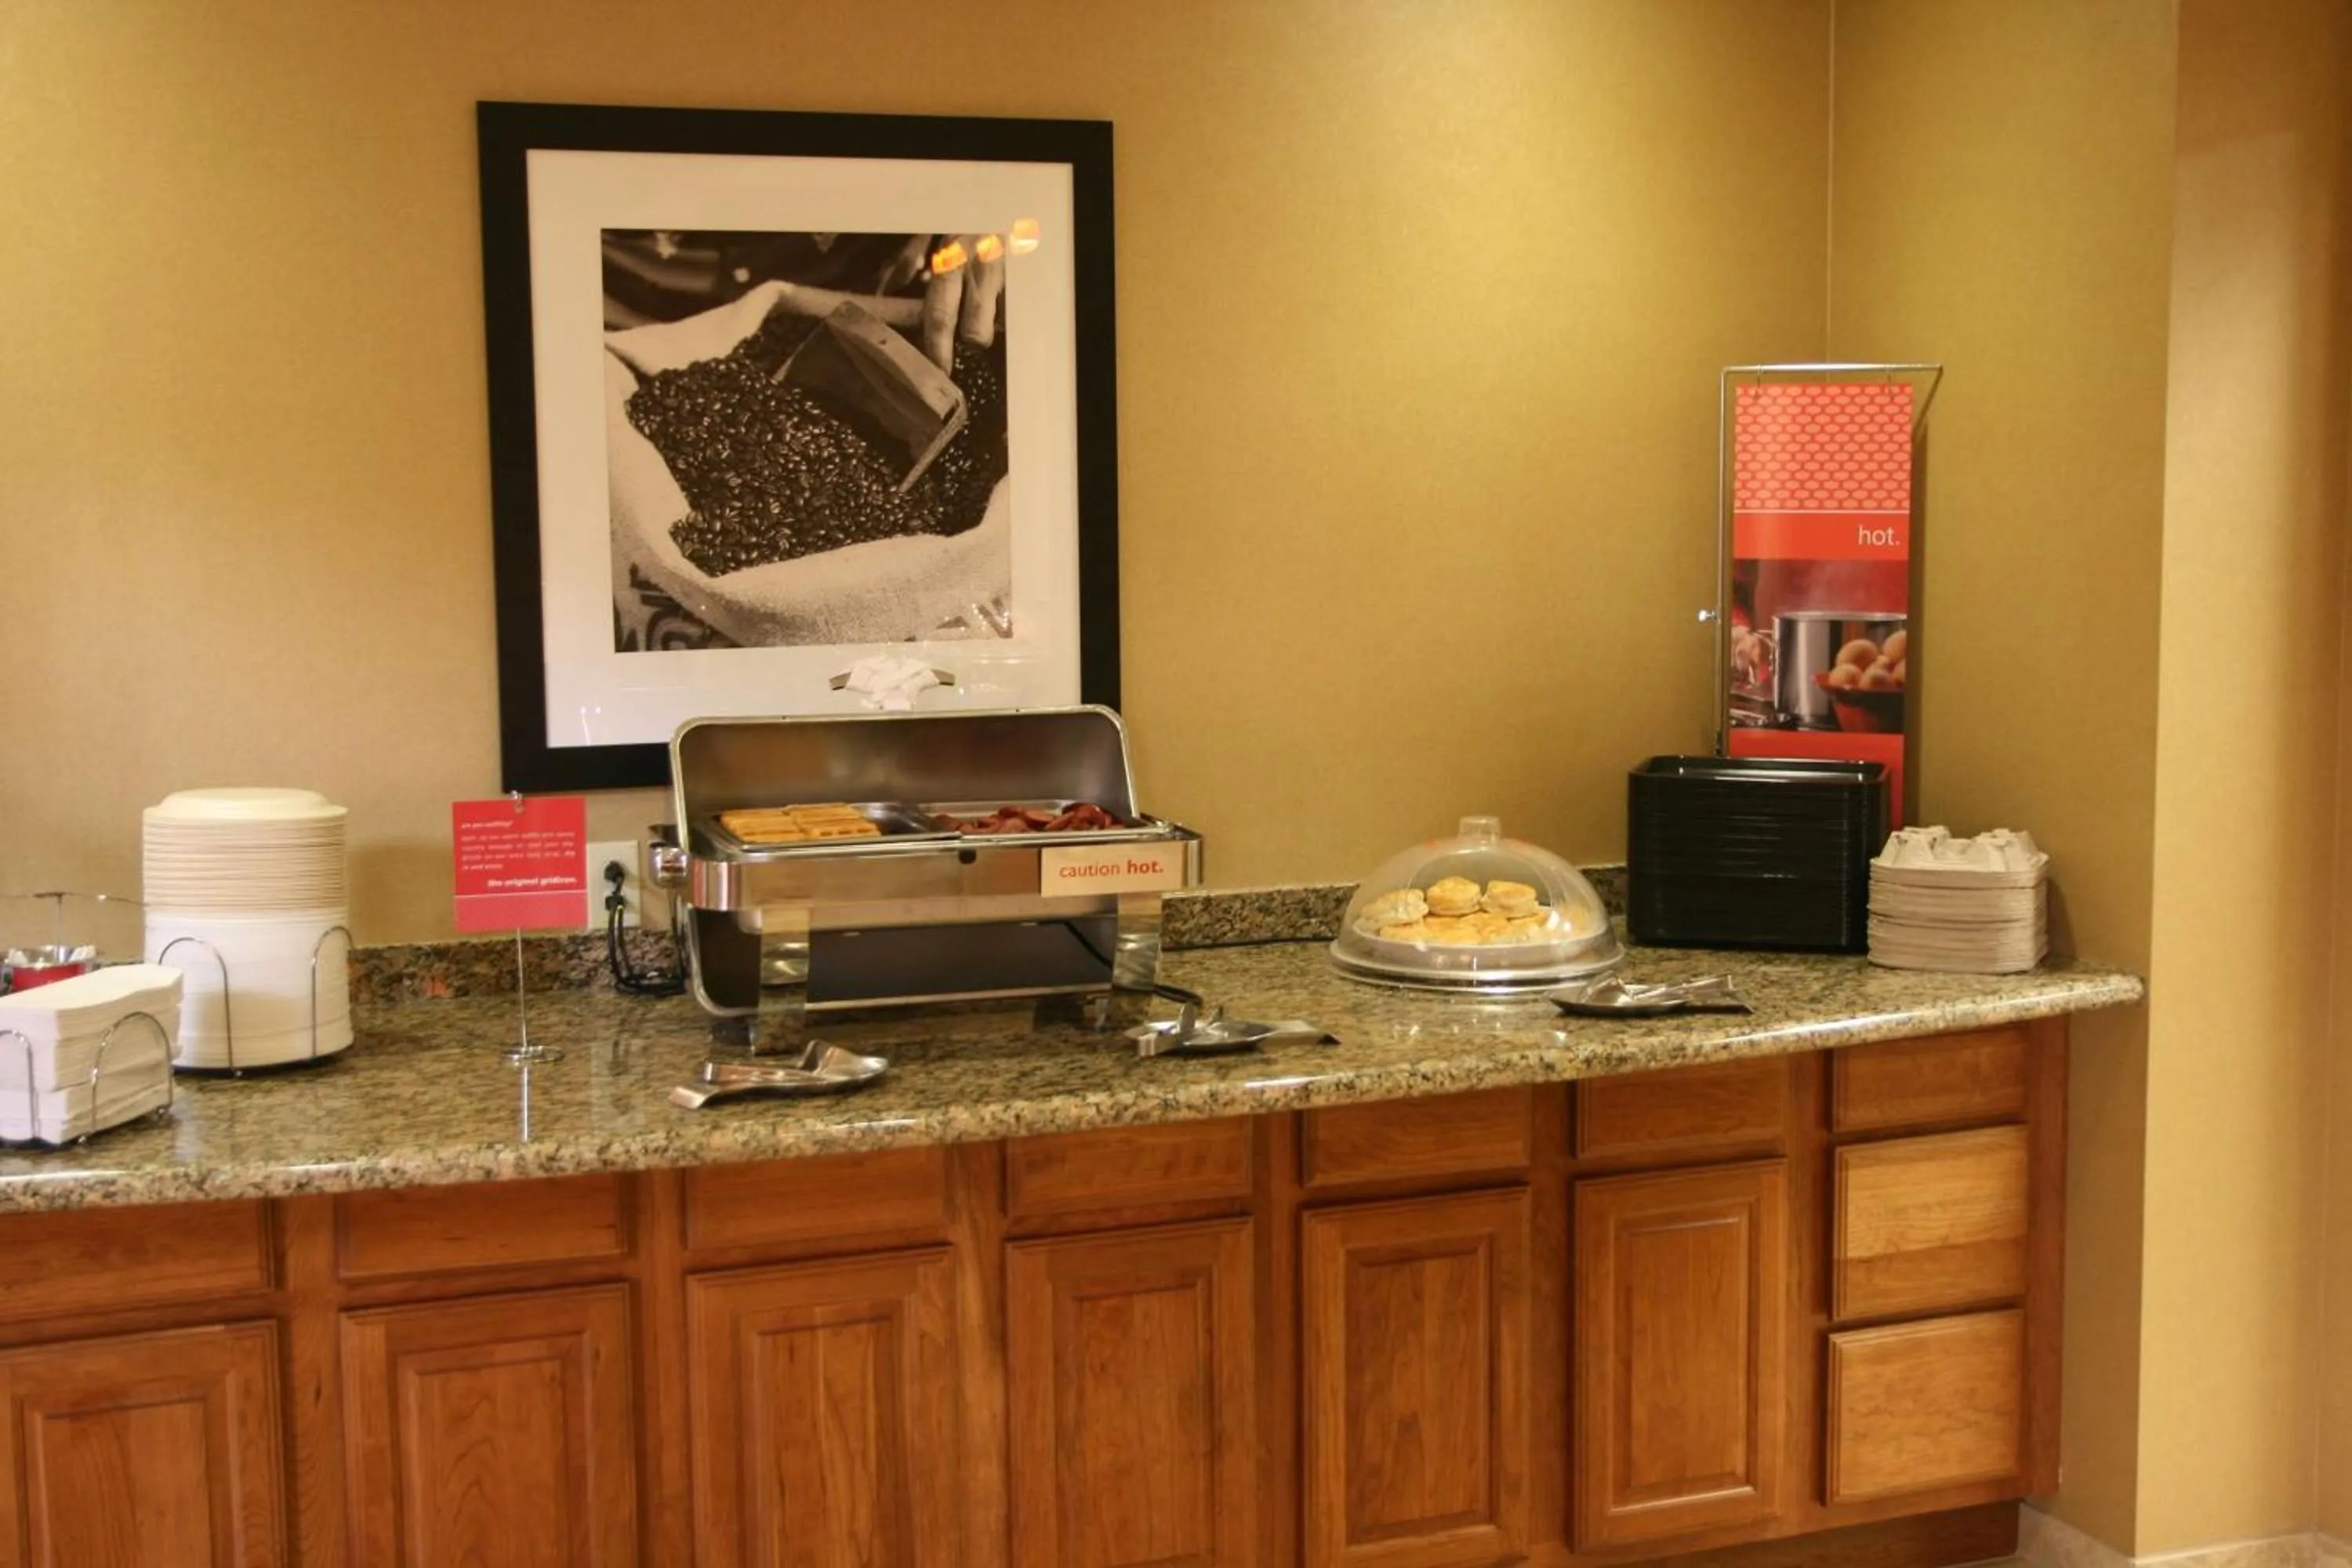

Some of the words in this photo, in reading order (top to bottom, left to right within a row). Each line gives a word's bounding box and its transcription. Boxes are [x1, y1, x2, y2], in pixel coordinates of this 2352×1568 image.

[1858, 524, 1900, 546] hot.
[1058, 862, 1120, 877] caution
[1127, 859, 1163, 874] hot.
[504, 877, 539, 887] original
